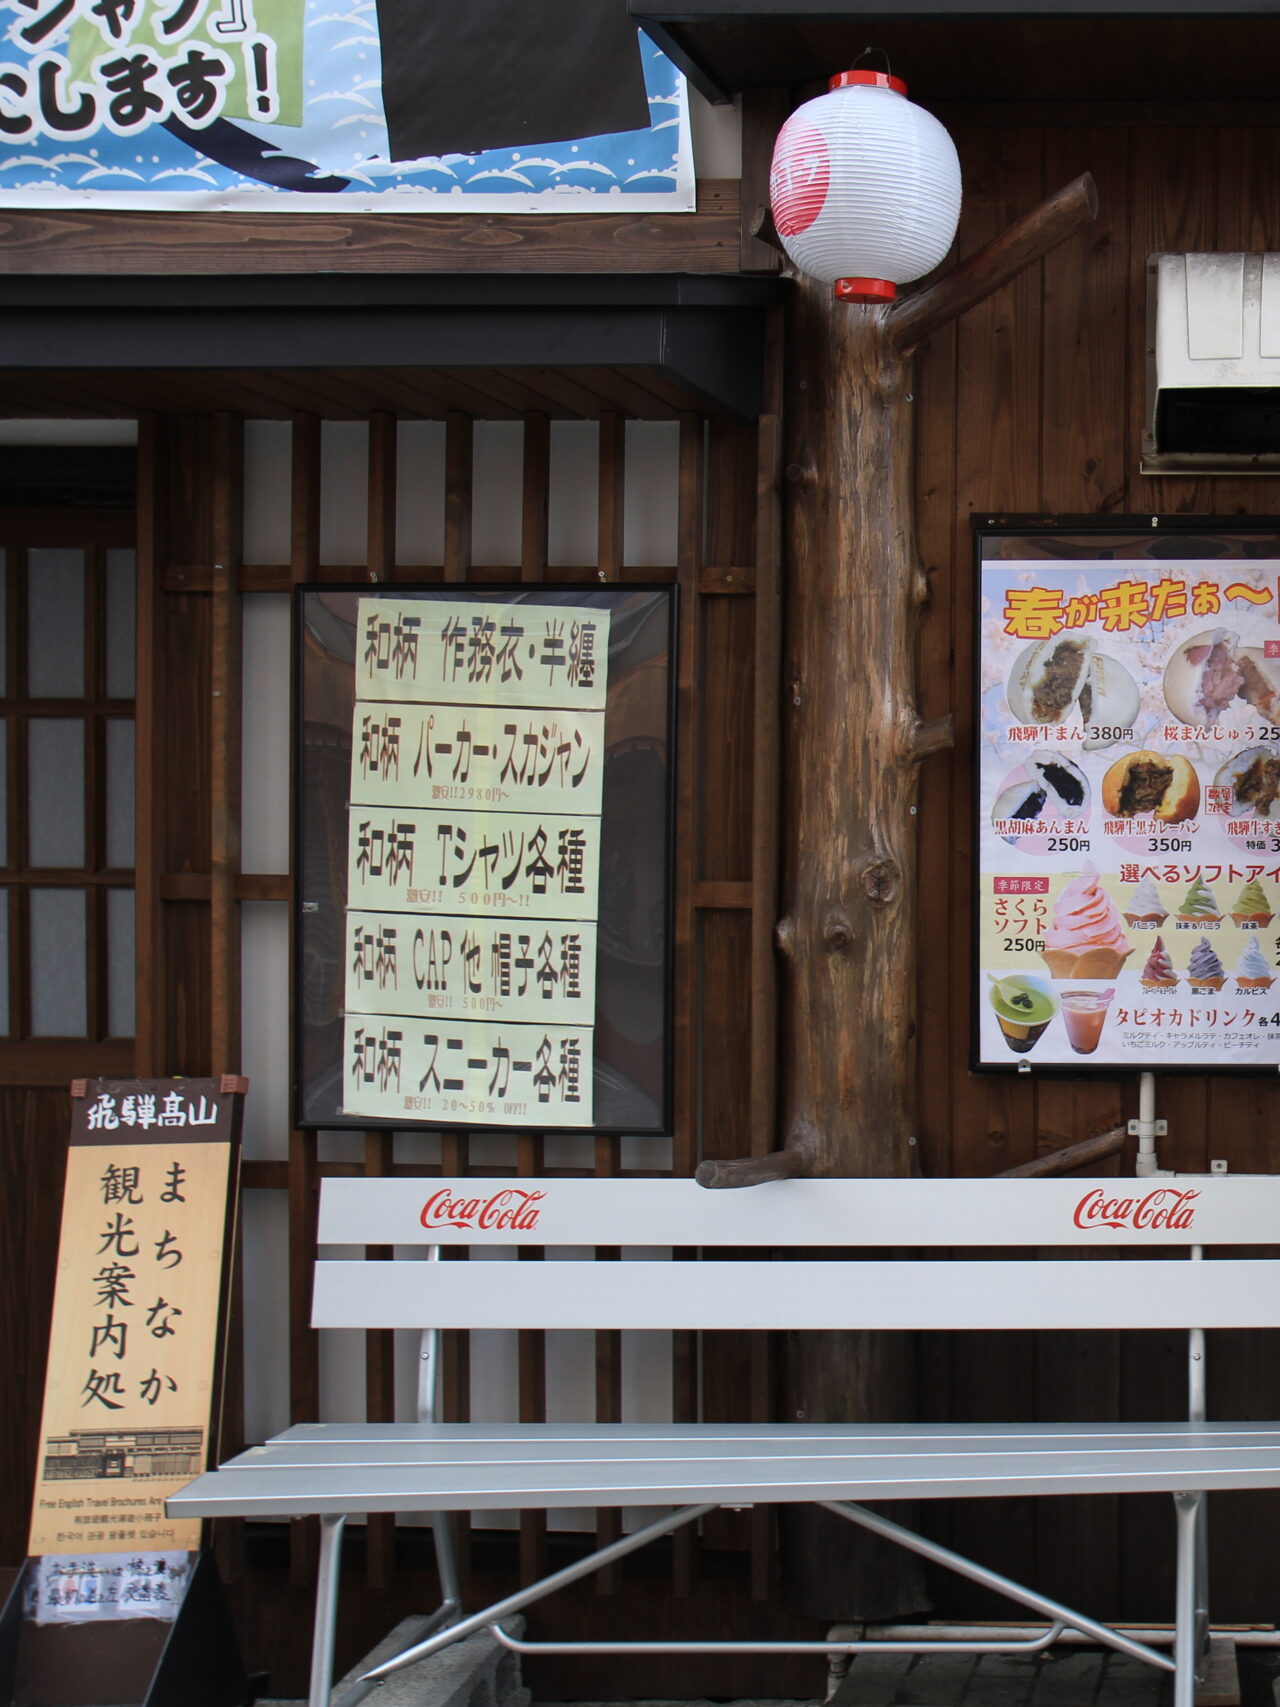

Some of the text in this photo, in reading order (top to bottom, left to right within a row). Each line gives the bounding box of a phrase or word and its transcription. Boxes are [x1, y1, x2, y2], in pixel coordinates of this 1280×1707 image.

[364, 612, 597, 688] 和柄 作務衣・半纏
[1007, 726, 1134, 742] 飛騨牛まん 380円
[1164, 725, 1256, 742] 桜まんじゅう
[360, 712, 591, 789] 和柄 パーカー・スカジャン
[995, 819, 1089, 836] 黒胡麻あんまん
[1104, 819, 1200, 836] 飛騨牛黒カレーパン
[1047, 838, 1090, 852] 250円
[1148, 838, 1192, 852] 350円
[1246, 840, 1266, 850] 特価
[356, 818, 587, 894] 和柄 Tシャツ各種
[997, 879, 1045, 892] 季節限定
[994, 898, 1048, 917] さくら
[994, 917, 1048, 935] ソフト
[1133, 922, 1156, 930] バニラ
[1242, 922, 1258, 930] 抹茶
[1003, 938, 1045, 952] 250円
[353, 923, 582, 1000] 和柄 CAP 他 帽子各種
[1191, 987, 1215, 995] 黒ごま
[1235, 987, 1267, 995] カルピス
[1115, 1008, 1256, 1027] タピオカドリンク
[352, 1026, 582, 1103] 和柄 スニーカー各種
[420, 1187, 548, 1232] Coca-Cola
[1072, 1187, 1202, 1232] Coca-Cola
[81, 1163, 143, 1411] 観光案内処
[139, 1161, 188, 1407] まちなか
